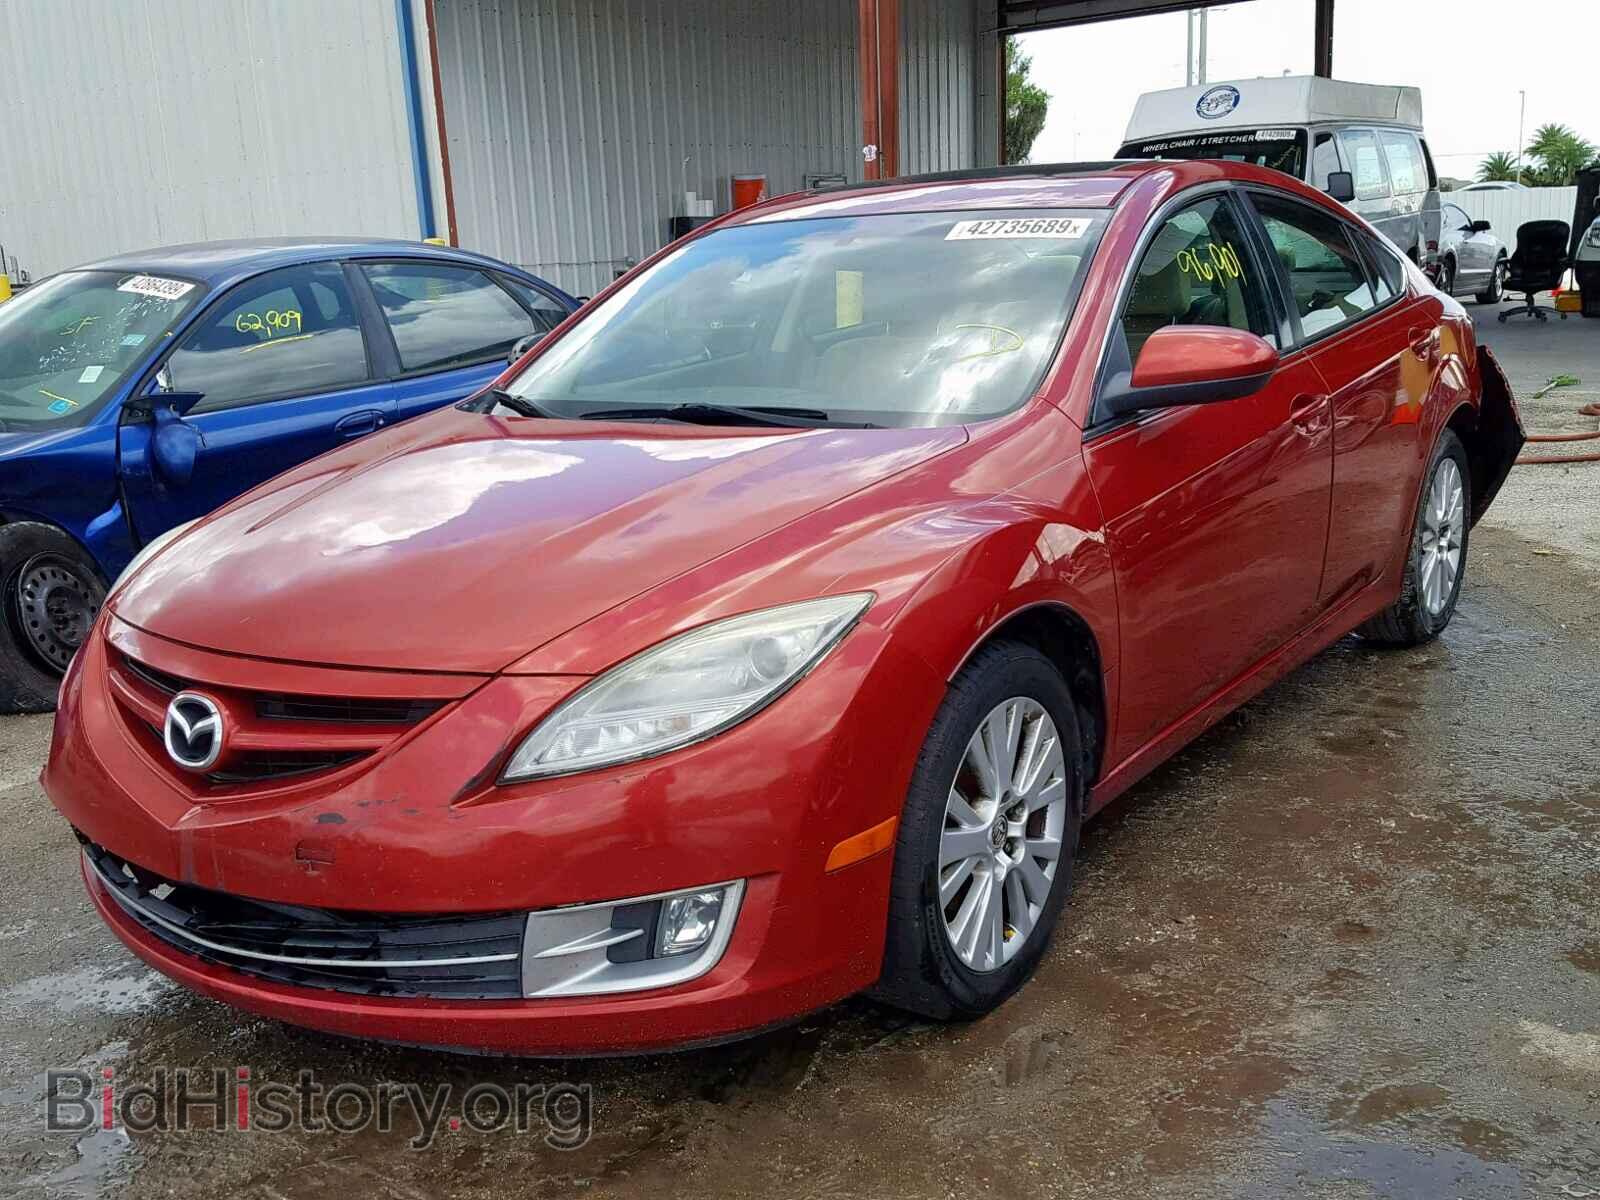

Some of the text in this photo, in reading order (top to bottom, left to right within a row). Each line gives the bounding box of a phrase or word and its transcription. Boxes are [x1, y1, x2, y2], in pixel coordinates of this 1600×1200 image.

[1143, 139, 1195, 152] WHEELCHAIR
[1201, 135, 1254, 145] STRETCHER
[236, 310, 302, 337] 62,909
